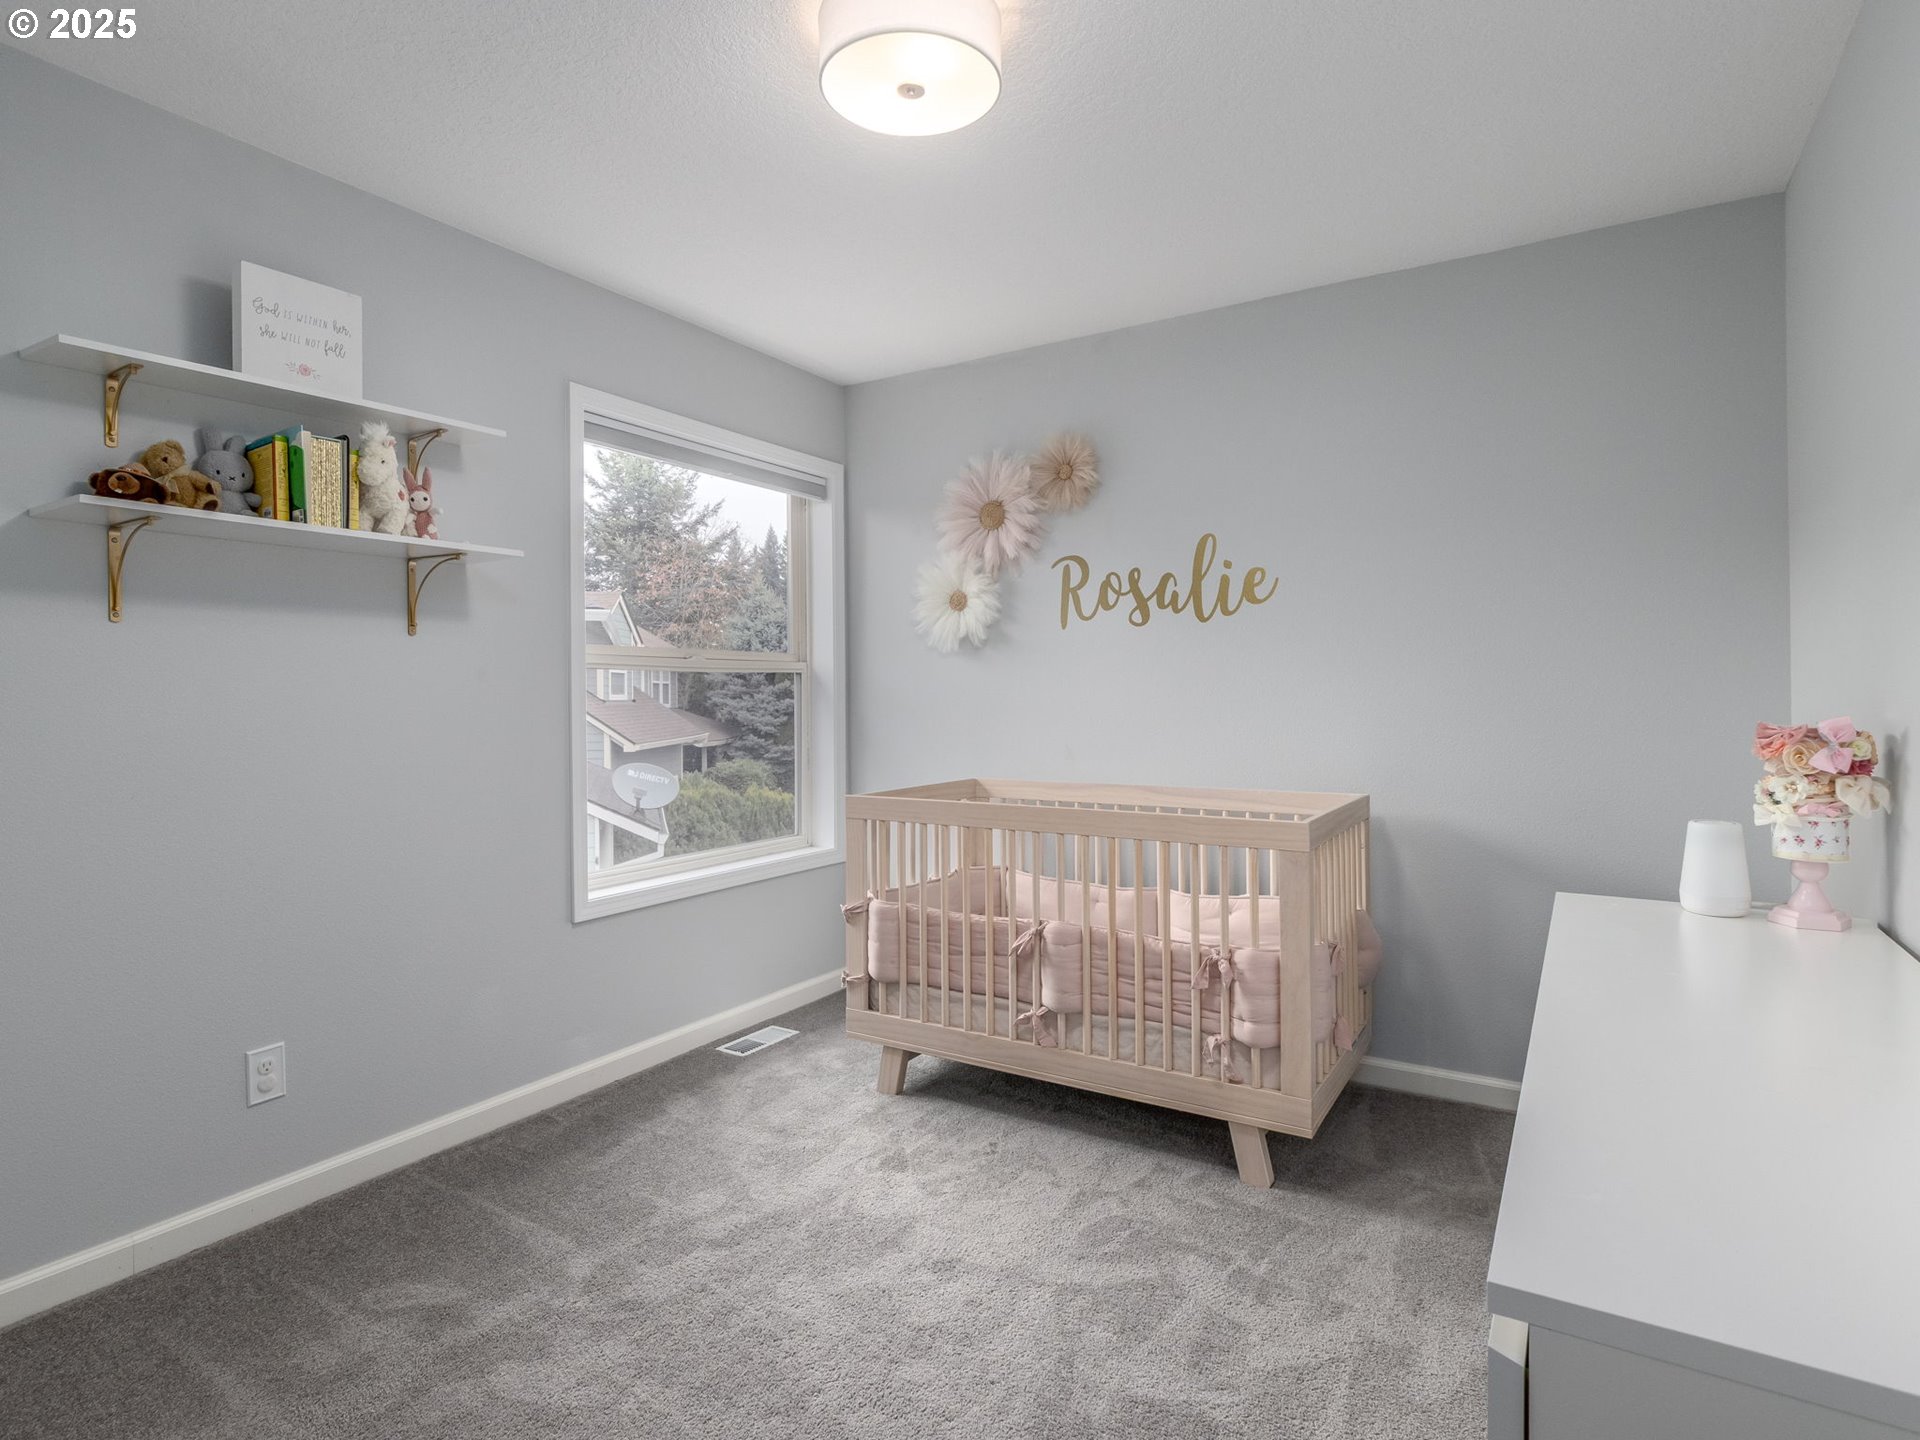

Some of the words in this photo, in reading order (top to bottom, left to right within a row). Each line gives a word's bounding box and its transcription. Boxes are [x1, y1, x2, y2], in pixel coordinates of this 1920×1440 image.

[253, 297, 280, 318] God
[284, 310, 292, 320] IS
[297, 315, 327, 328] WITHIN
[333, 320, 351, 337] her,
[260, 324, 277, 338] she
[280, 331, 301, 345] WILL
[305, 338, 321, 349] NOT
[324, 341, 345, 358] fall
[1051, 533, 1279, 630] Rosalie
[640, 772, 670, 784] DIRECTV
